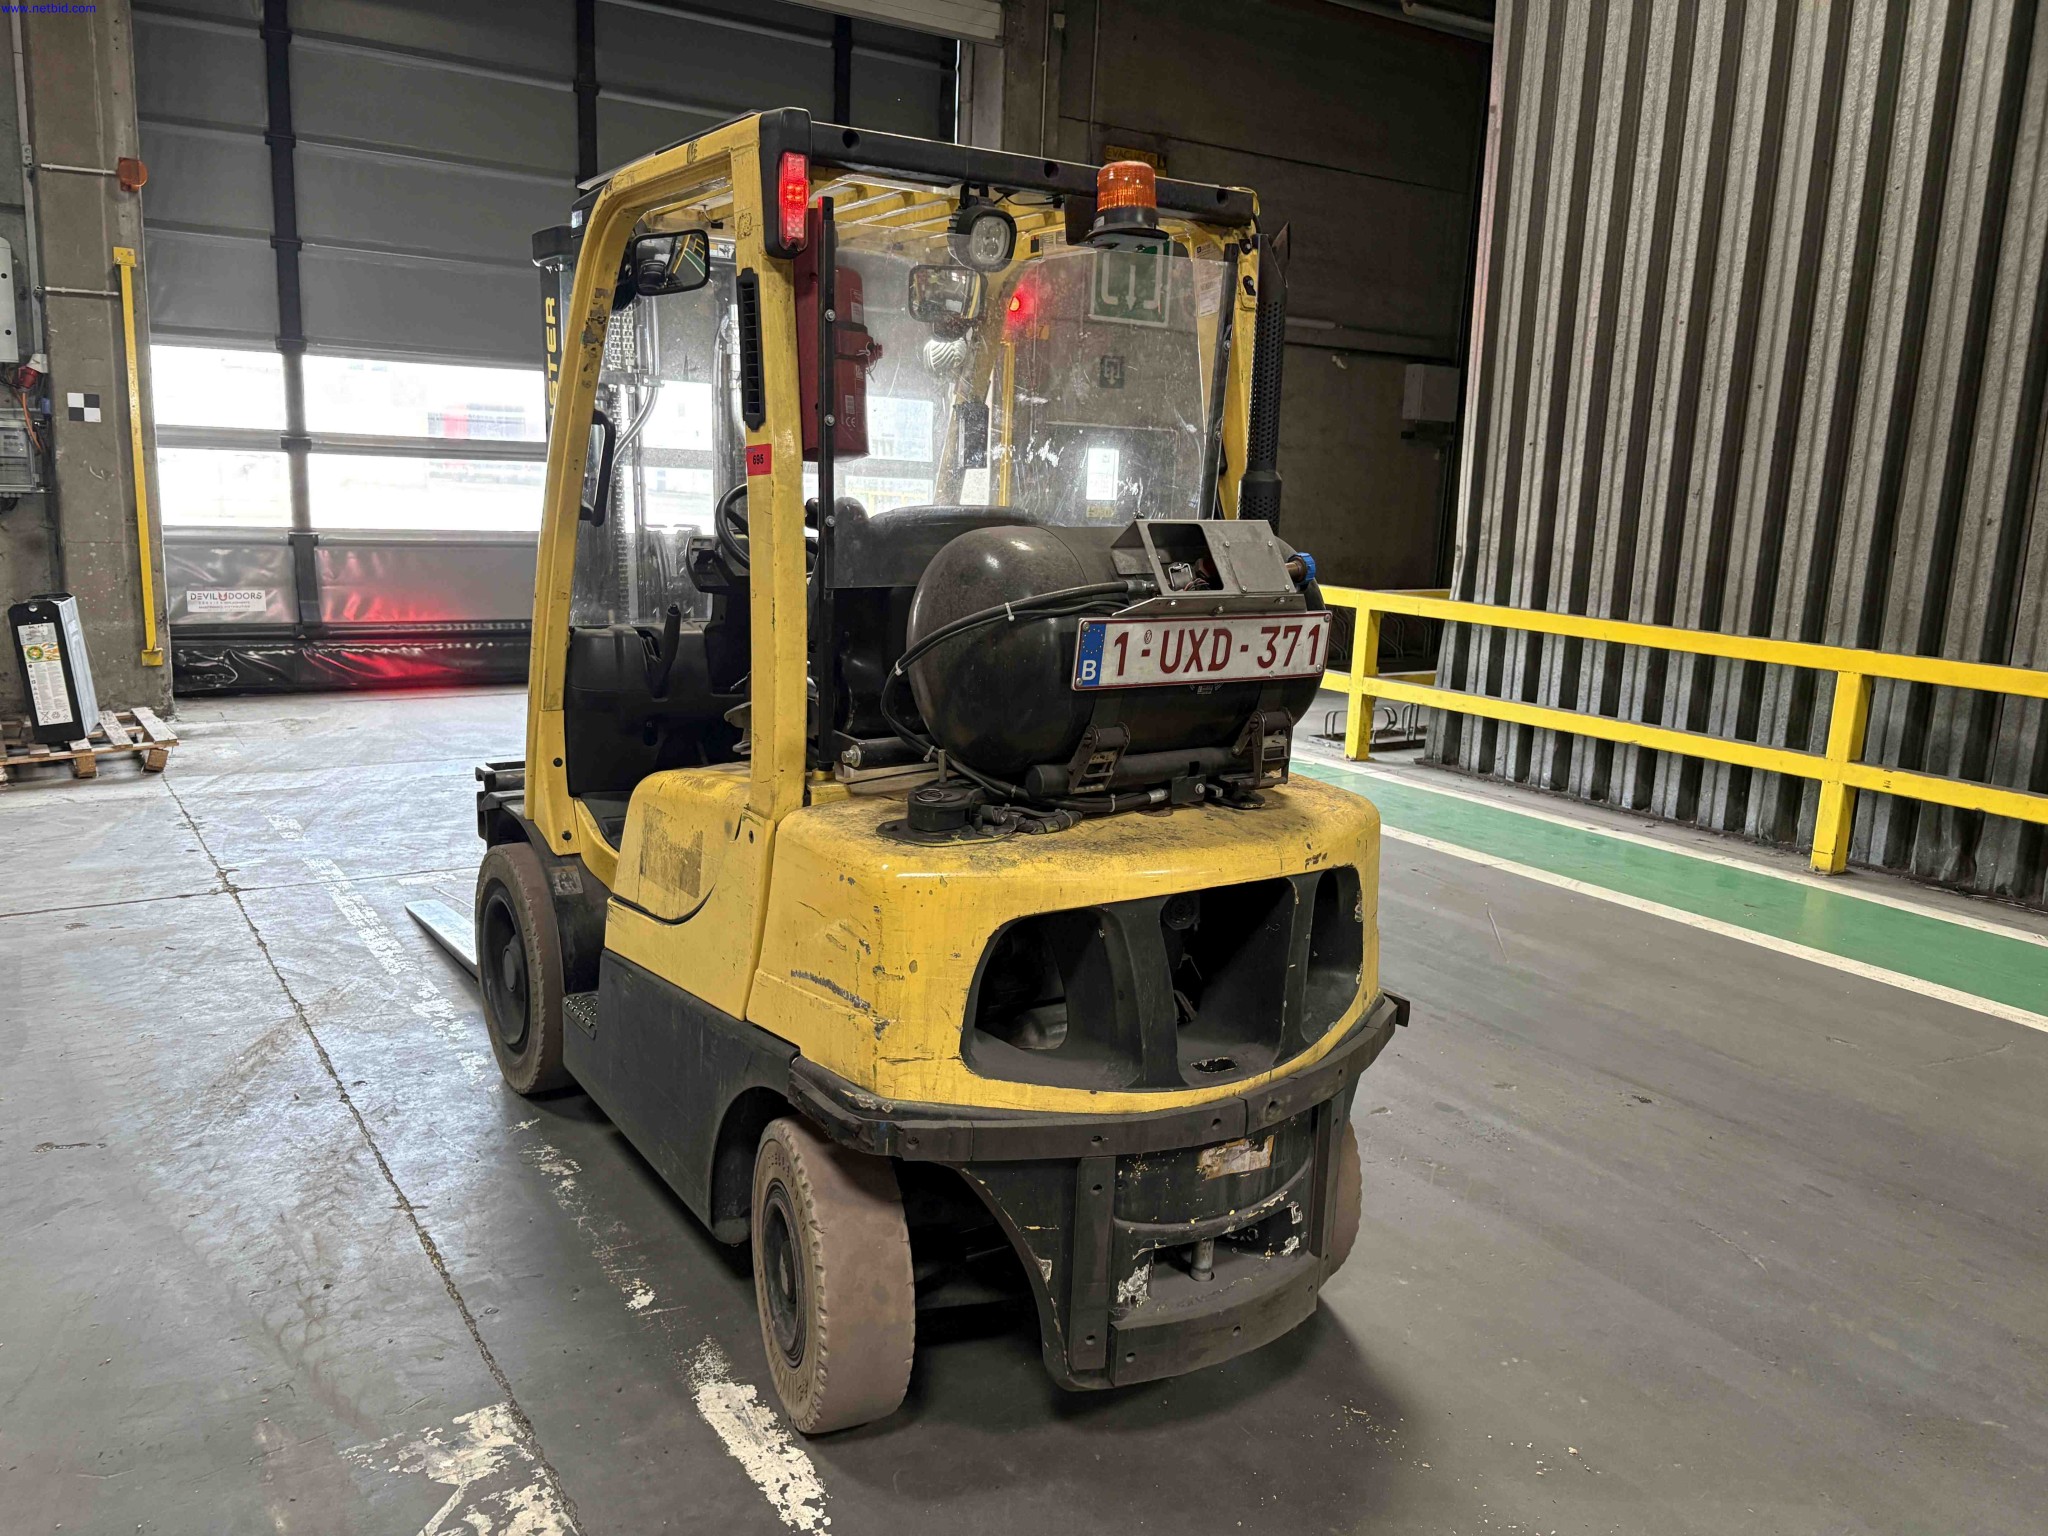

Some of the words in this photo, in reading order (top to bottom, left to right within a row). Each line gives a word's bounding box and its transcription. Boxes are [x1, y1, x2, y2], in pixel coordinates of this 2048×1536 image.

[752, 454, 764, 465] 695
[190, 592, 218, 600] DEVIL
[228, 592, 262, 600] DOORS
[1081, 659, 1097, 681] B
